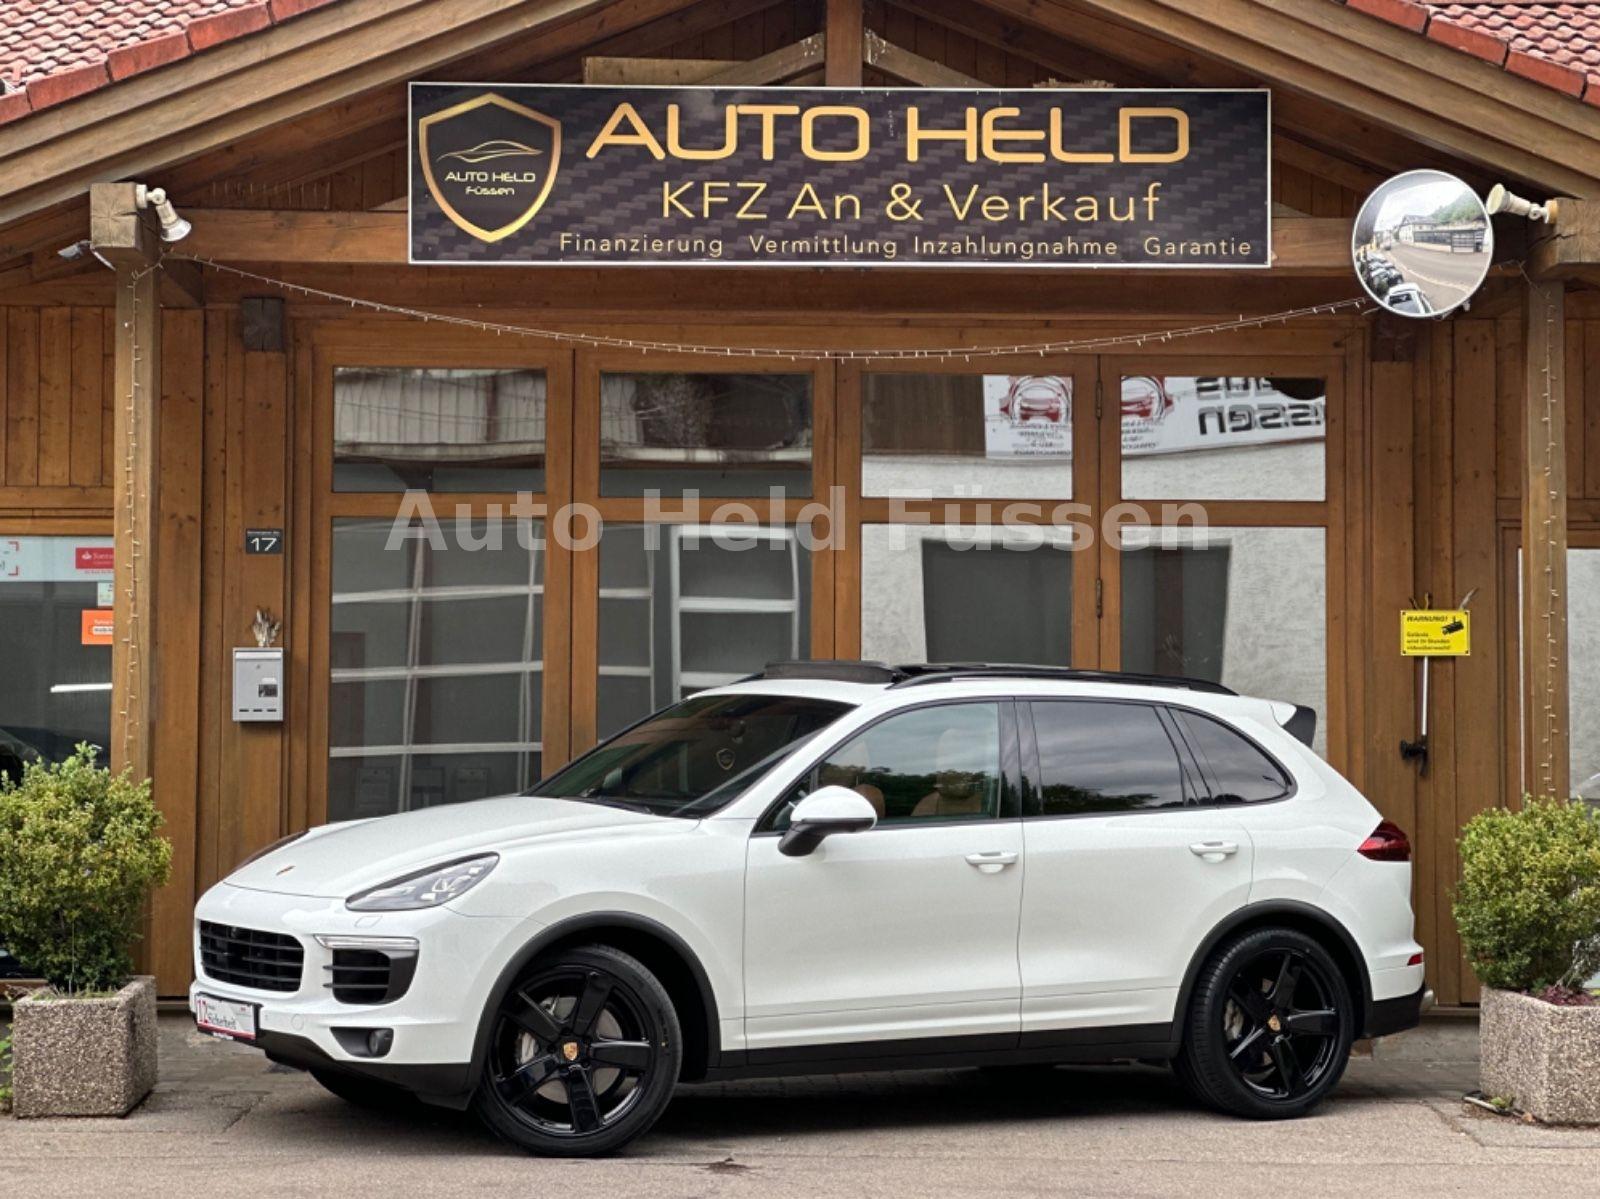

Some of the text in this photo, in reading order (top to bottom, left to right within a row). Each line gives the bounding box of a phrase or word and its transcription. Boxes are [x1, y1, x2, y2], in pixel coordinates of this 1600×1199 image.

[586, 102, 1190, 163] AUTO HELD
[444, 171, 536, 183] AUTO HELD
[663, 181, 1162, 221] KFZ An & Verkauf
[560, 232, 1252, 259] Finanzierung Vermittlung Inzahlungnahme Garantie
[250, 537, 277, 552] 17
